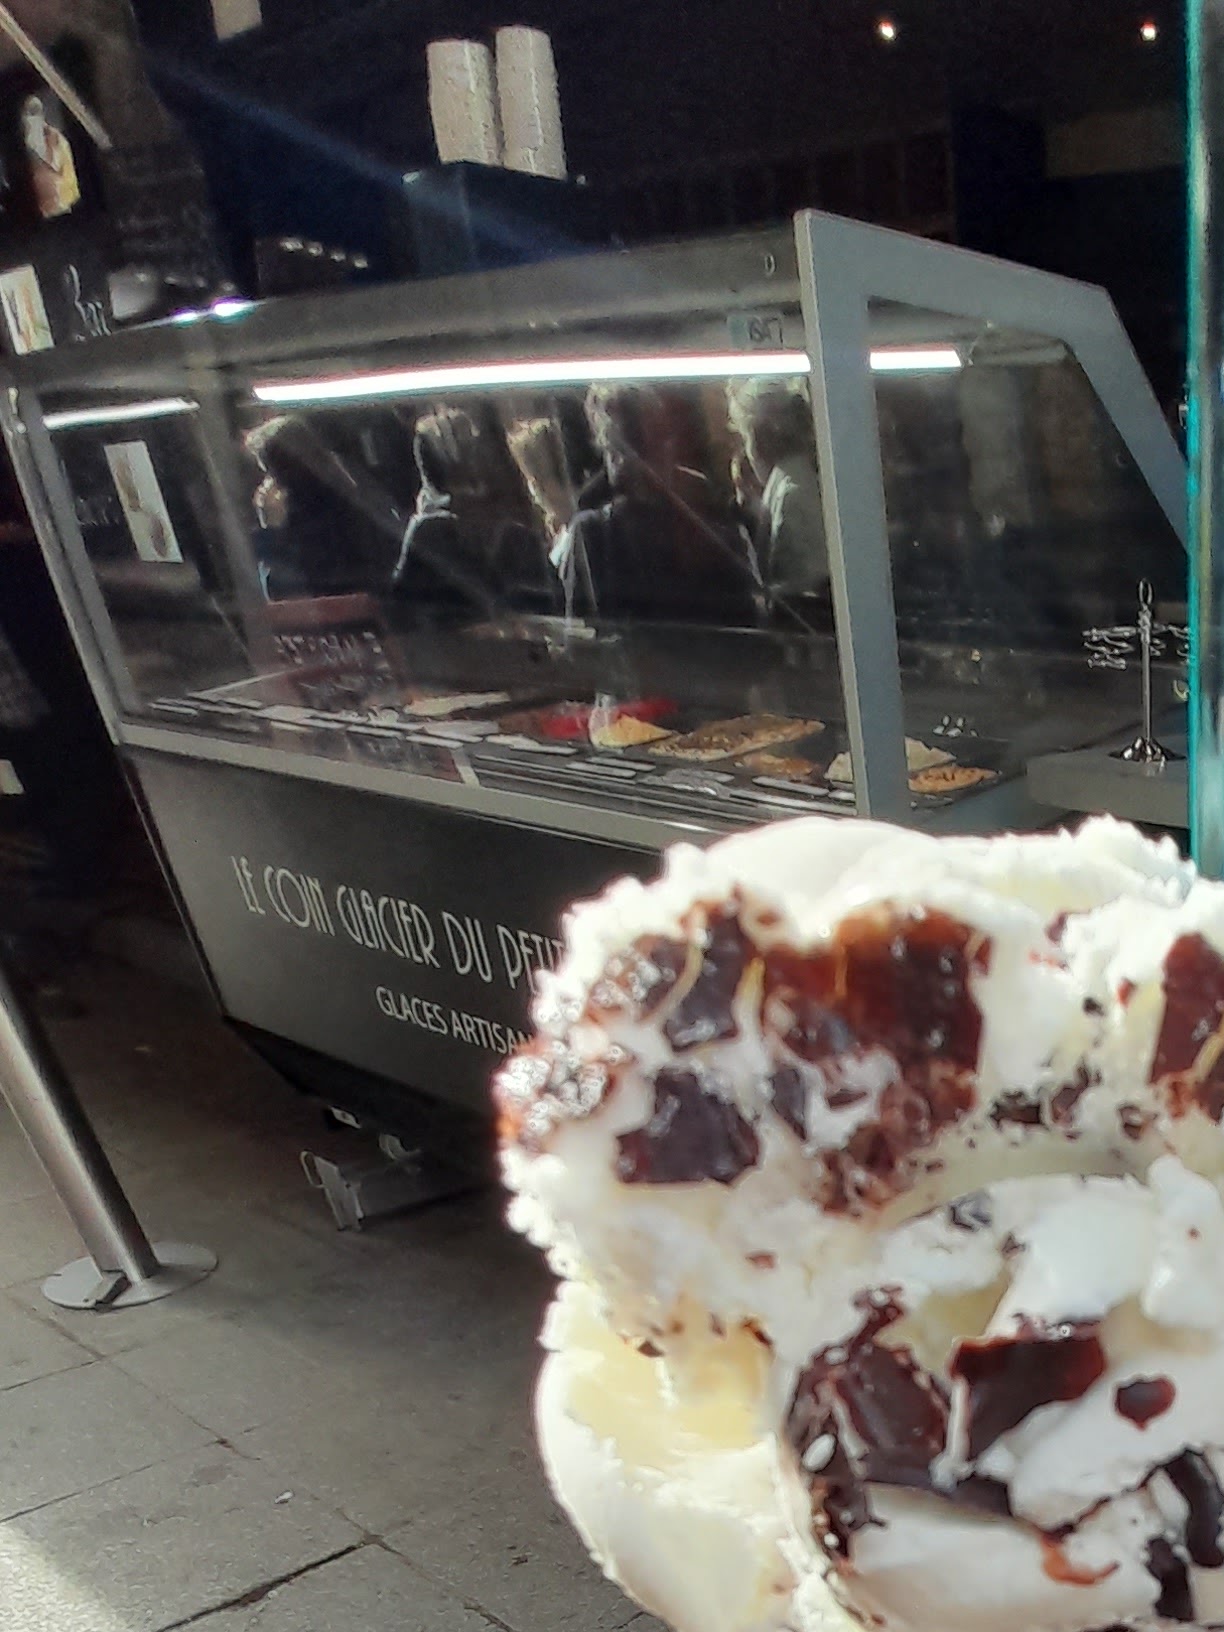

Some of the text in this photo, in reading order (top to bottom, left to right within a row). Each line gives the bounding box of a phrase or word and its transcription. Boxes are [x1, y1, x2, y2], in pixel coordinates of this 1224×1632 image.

[231, 855, 266, 915] LE
[263, 865, 335, 936] COIN
[336, 884, 441, 968] GLACIER
[442, 911, 493, 983] DU
[375, 986, 448, 1035] GLACES
